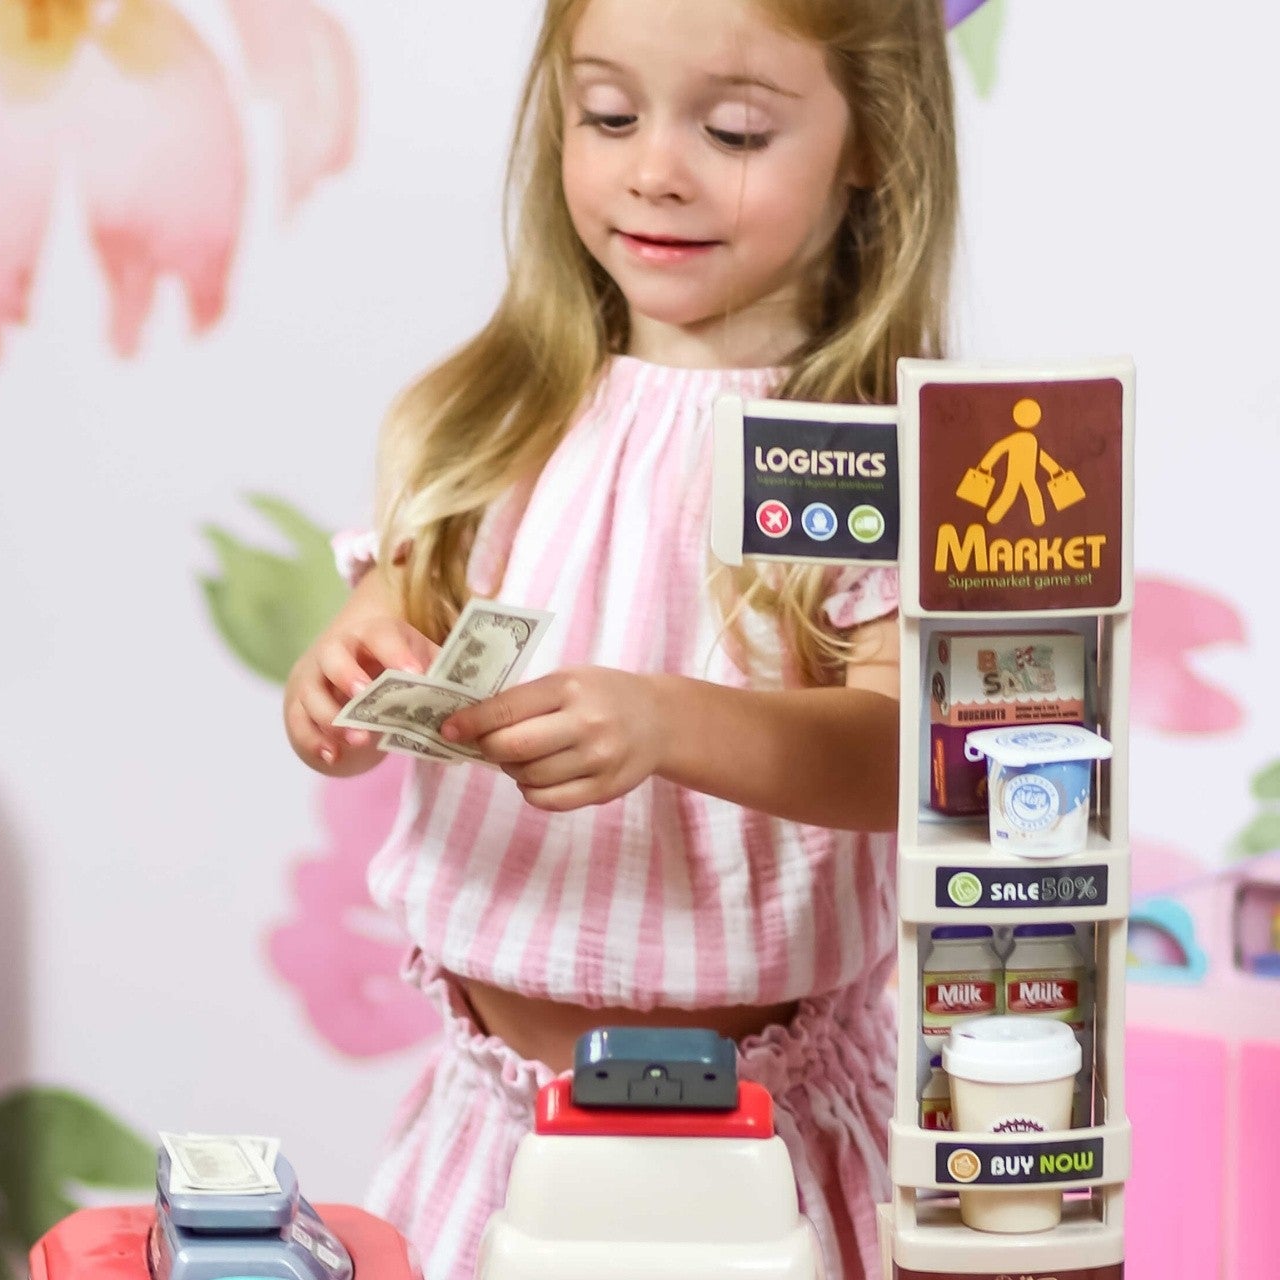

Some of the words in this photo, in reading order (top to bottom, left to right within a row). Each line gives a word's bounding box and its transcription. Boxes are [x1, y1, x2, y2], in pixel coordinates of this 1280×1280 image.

[755, 446, 887, 478] LOGISTICS
[934, 523, 1107, 573] MARKET
[948, 573, 1031, 591] Supermarket
[1034, 577, 1071, 590] game
[1075, 573, 1093, 584] set
[990, 882, 1040, 901] SALE
[1041, 875, 1099, 901] 50%
[937, 984, 983, 1007] Milk
[1019, 982, 1064, 1004] Milk
[990, 1155, 1035, 1176] BUY
[1039, 1150, 1094, 1174] NOW
